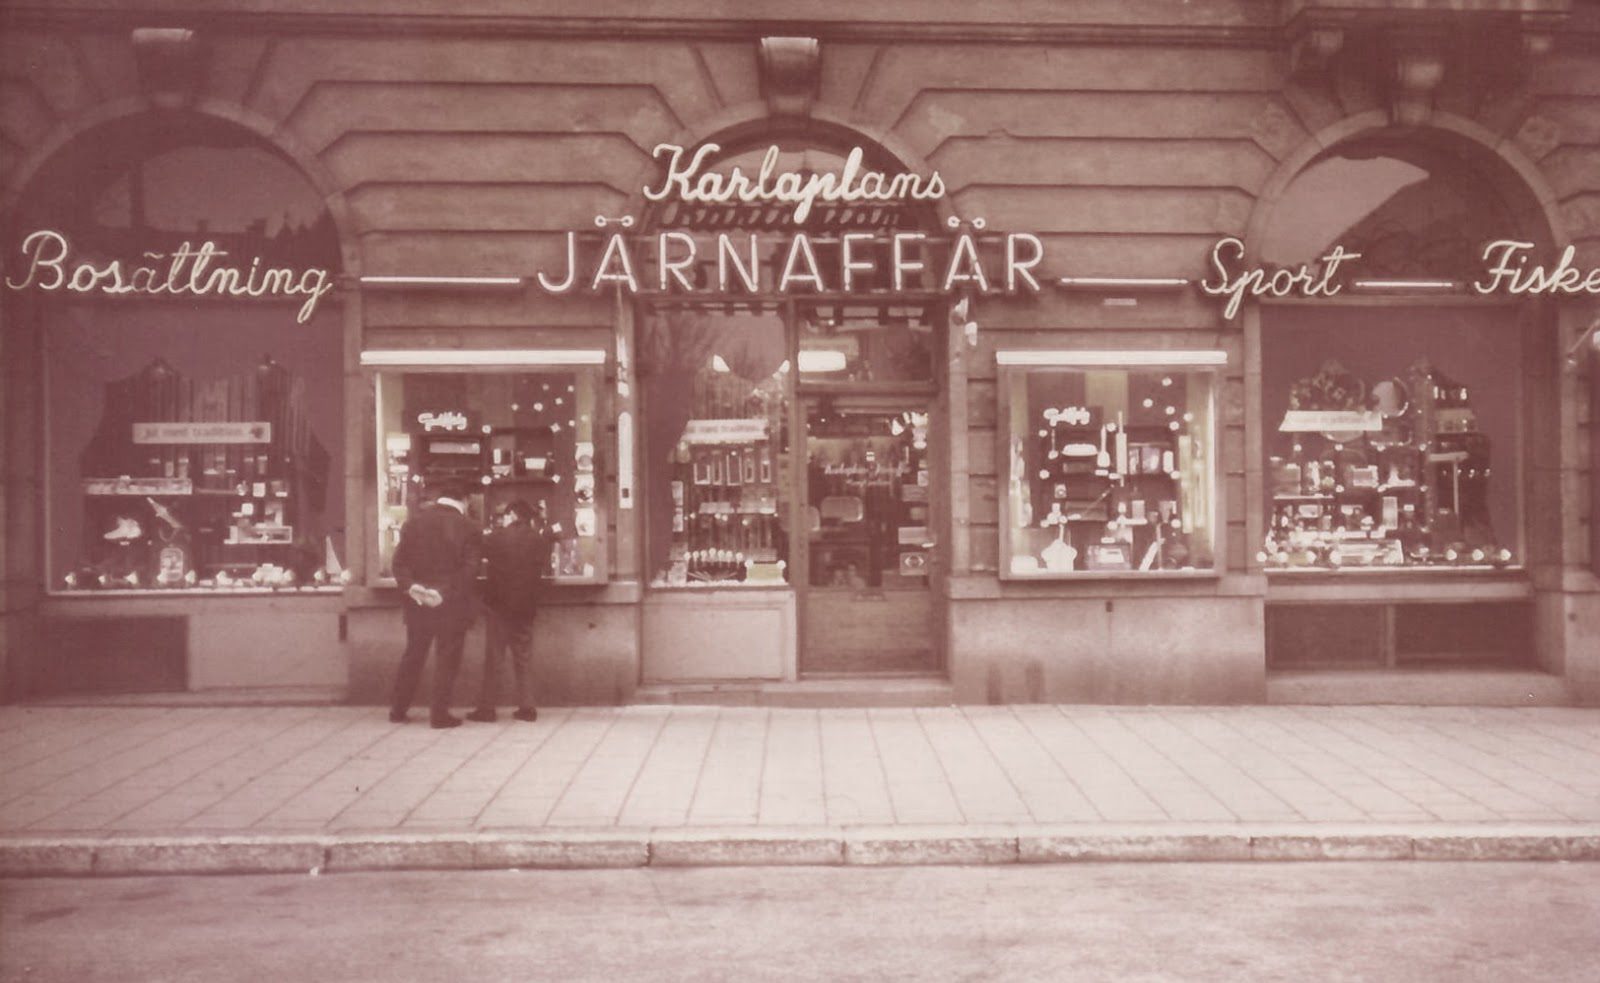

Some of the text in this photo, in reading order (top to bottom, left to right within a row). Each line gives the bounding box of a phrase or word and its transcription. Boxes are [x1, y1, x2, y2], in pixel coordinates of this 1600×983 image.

[643, 143, 946, 224] Karlaplans
[5, 230, 333, 323] Bosättning
[537, 215, 1045, 293] JÄRNAFFÄR
[1202, 237, 1362, 319] Sport
[1475, 239, 1600, 294] Fiske
